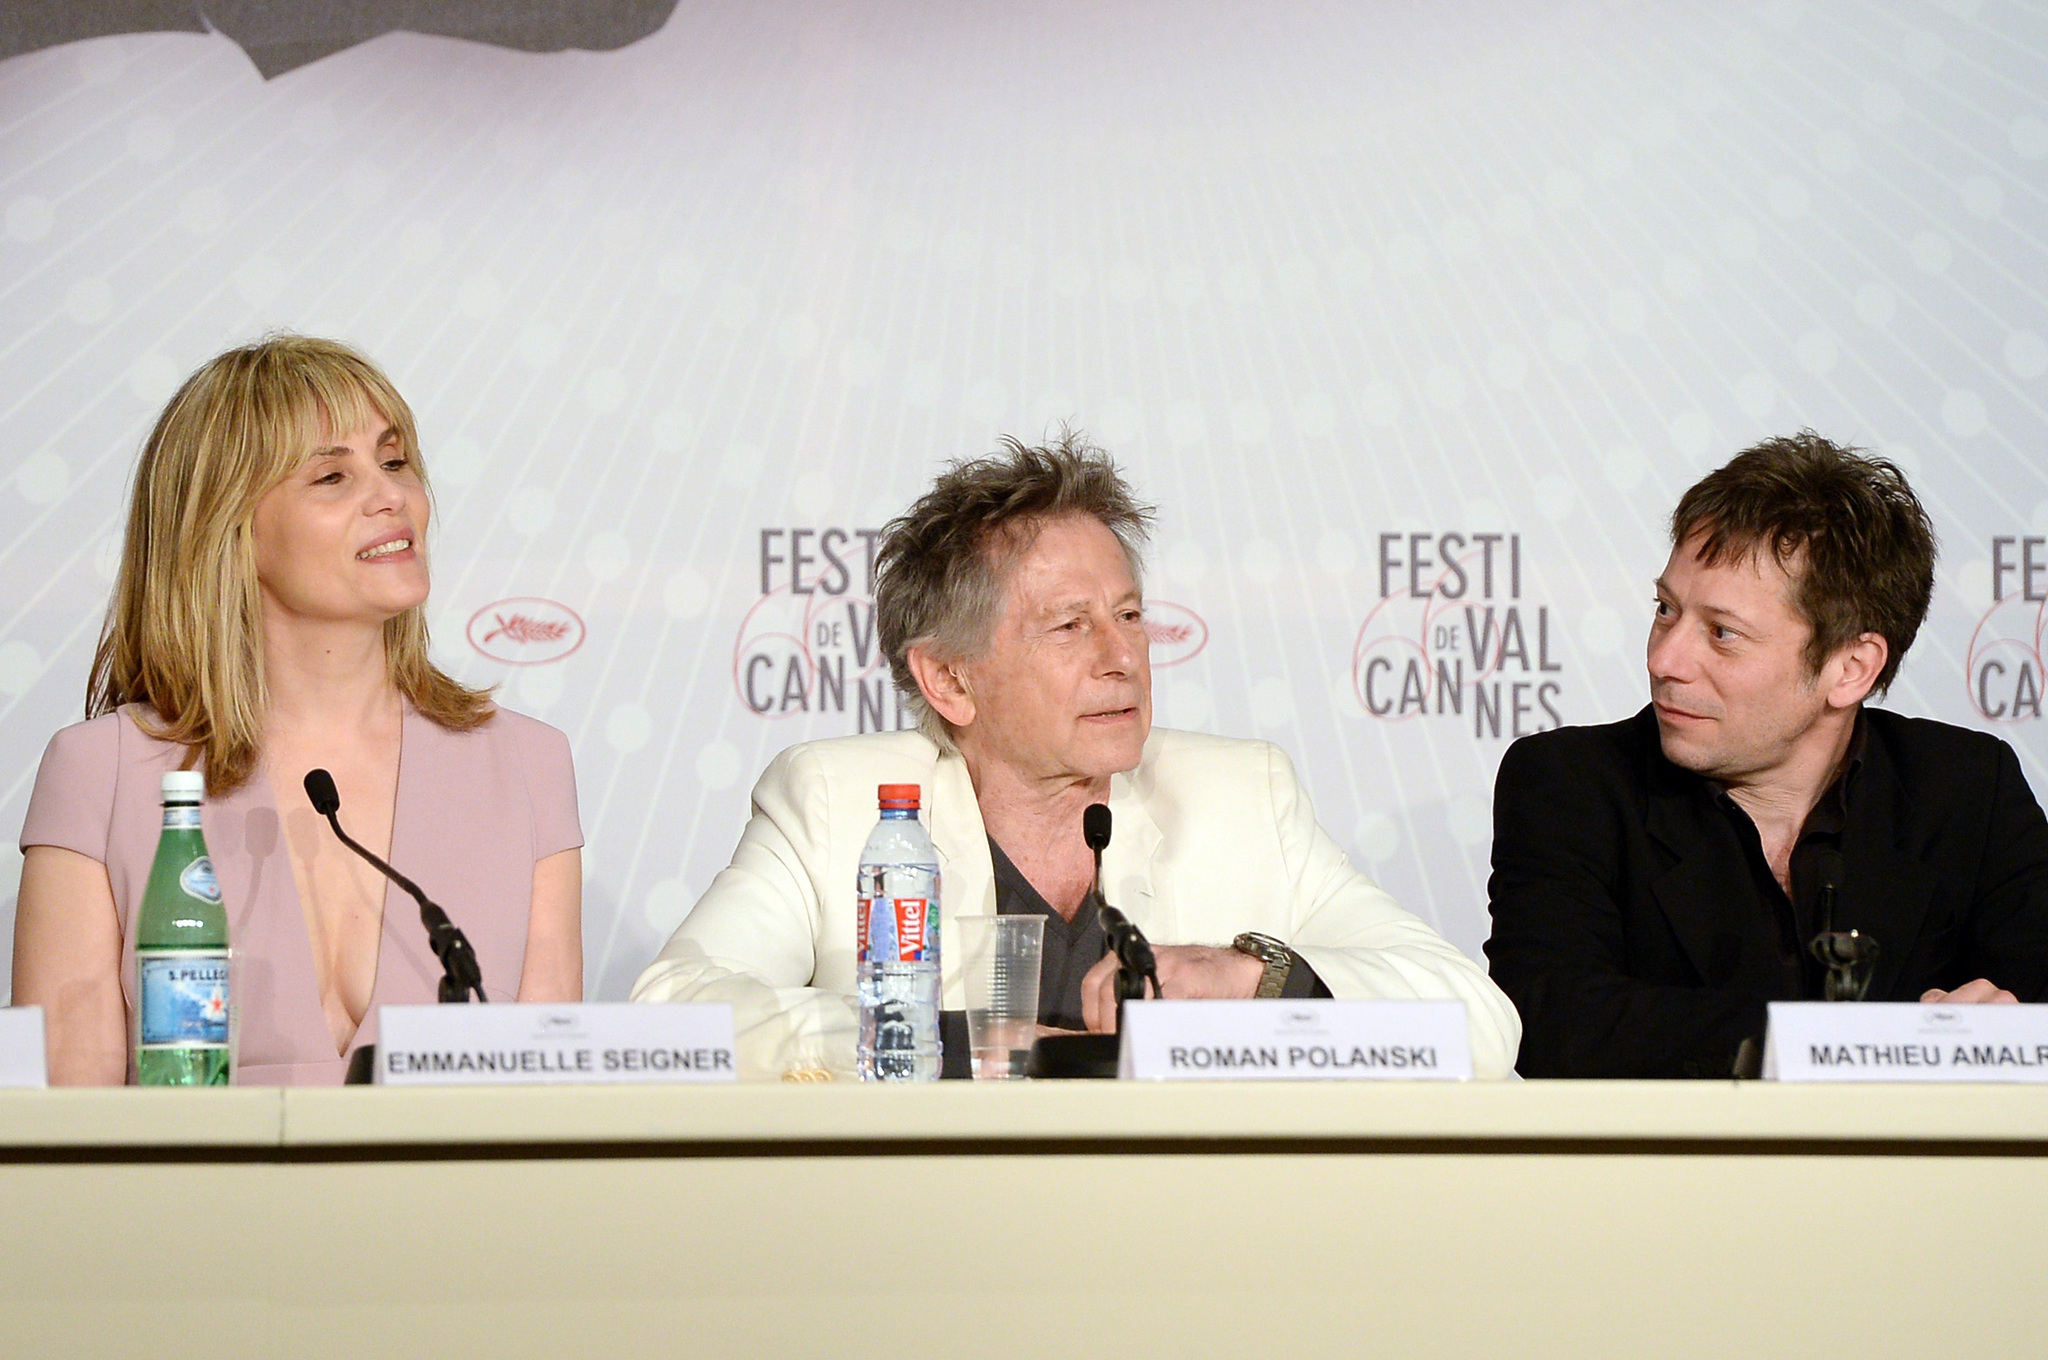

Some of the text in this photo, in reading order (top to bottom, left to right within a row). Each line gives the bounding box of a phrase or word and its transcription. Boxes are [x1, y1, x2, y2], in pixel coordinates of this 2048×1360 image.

[761, 528, 880, 596] FEST
[1379, 532, 1520, 600] FESTI
[1992, 535, 2048, 602] FE
[816, 602, 887, 668] DE V
[1435, 605, 1562, 672] DE VAL
[746, 654, 845, 713] CAN
[1365, 657, 1463, 715] CAN
[1475, 680, 1563, 740] NES
[1978, 659, 2041, 718] CA
[900, 901, 921, 955] Vittel
[387, 1048, 732, 1074] EMMANUELLE SEIGNER
[1170, 1046, 1438, 1069] ROMAN POLANSKI
[1810, 1044, 1941, 1067] MATHIEU
